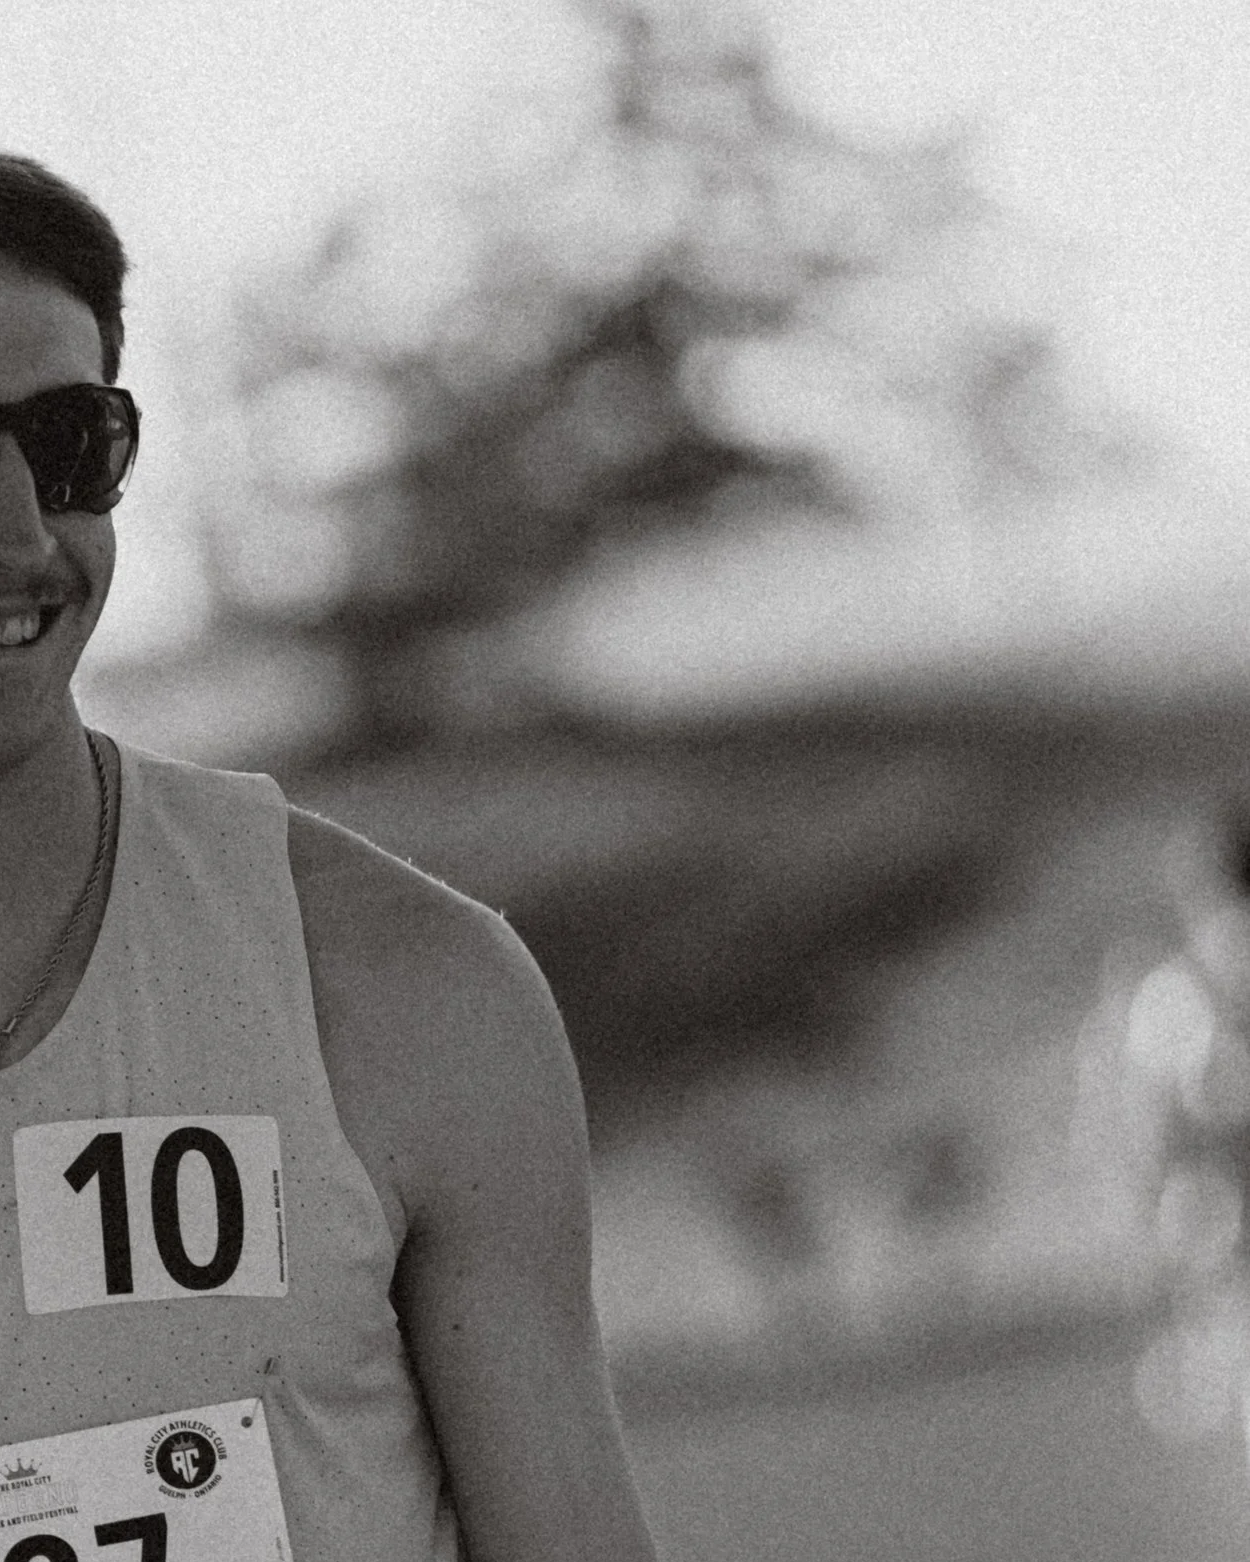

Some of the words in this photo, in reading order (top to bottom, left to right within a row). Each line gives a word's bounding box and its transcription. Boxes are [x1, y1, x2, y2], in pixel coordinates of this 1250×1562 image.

[62, 1126, 244, 1296] 10
[144, 1445, 155, 1474] ROYAL
[151, 1426, 169, 1444] CITY
[169, 1420, 216, 1438] ATHLETICS
[213, 1437, 227, 1460] CLUB
[11, 1479, 33, 1490] ROYAL
[34, 1475, 52, 1486] CITY
[194, 1474, 222, 1498] ONTARIO
[7, 1516, 22, 1526] AND
